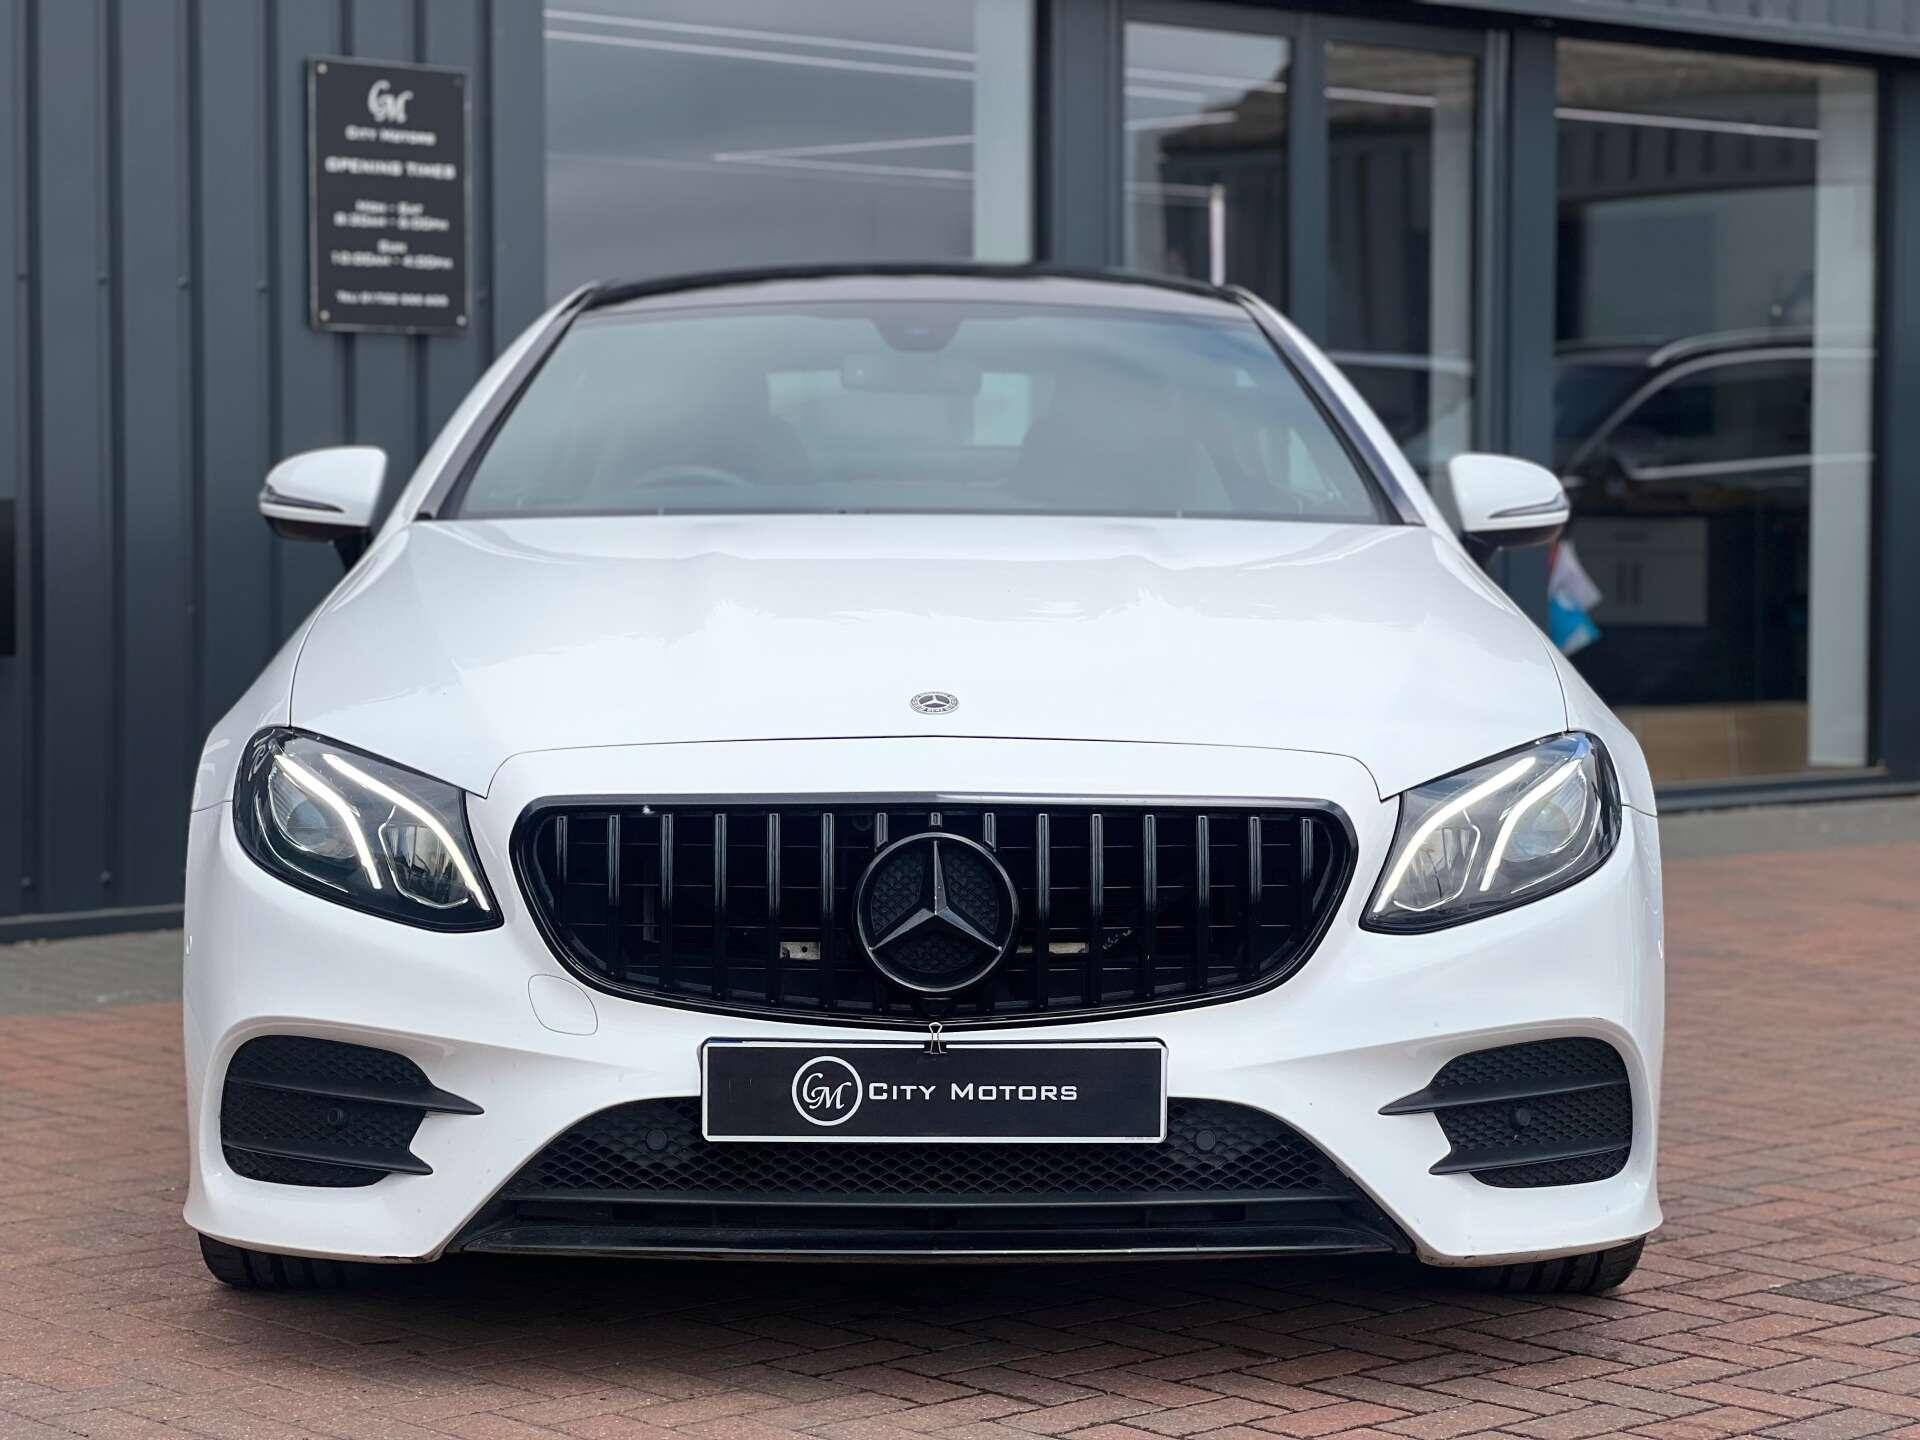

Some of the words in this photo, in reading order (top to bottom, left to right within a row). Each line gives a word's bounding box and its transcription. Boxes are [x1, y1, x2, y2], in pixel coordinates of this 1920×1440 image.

[325, 156, 402, 176] OPENING
[406, 162, 455, 179] TIMES
[868, 1082, 936, 1100] CITY
[951, 1083, 1078, 1100] MOTORS
